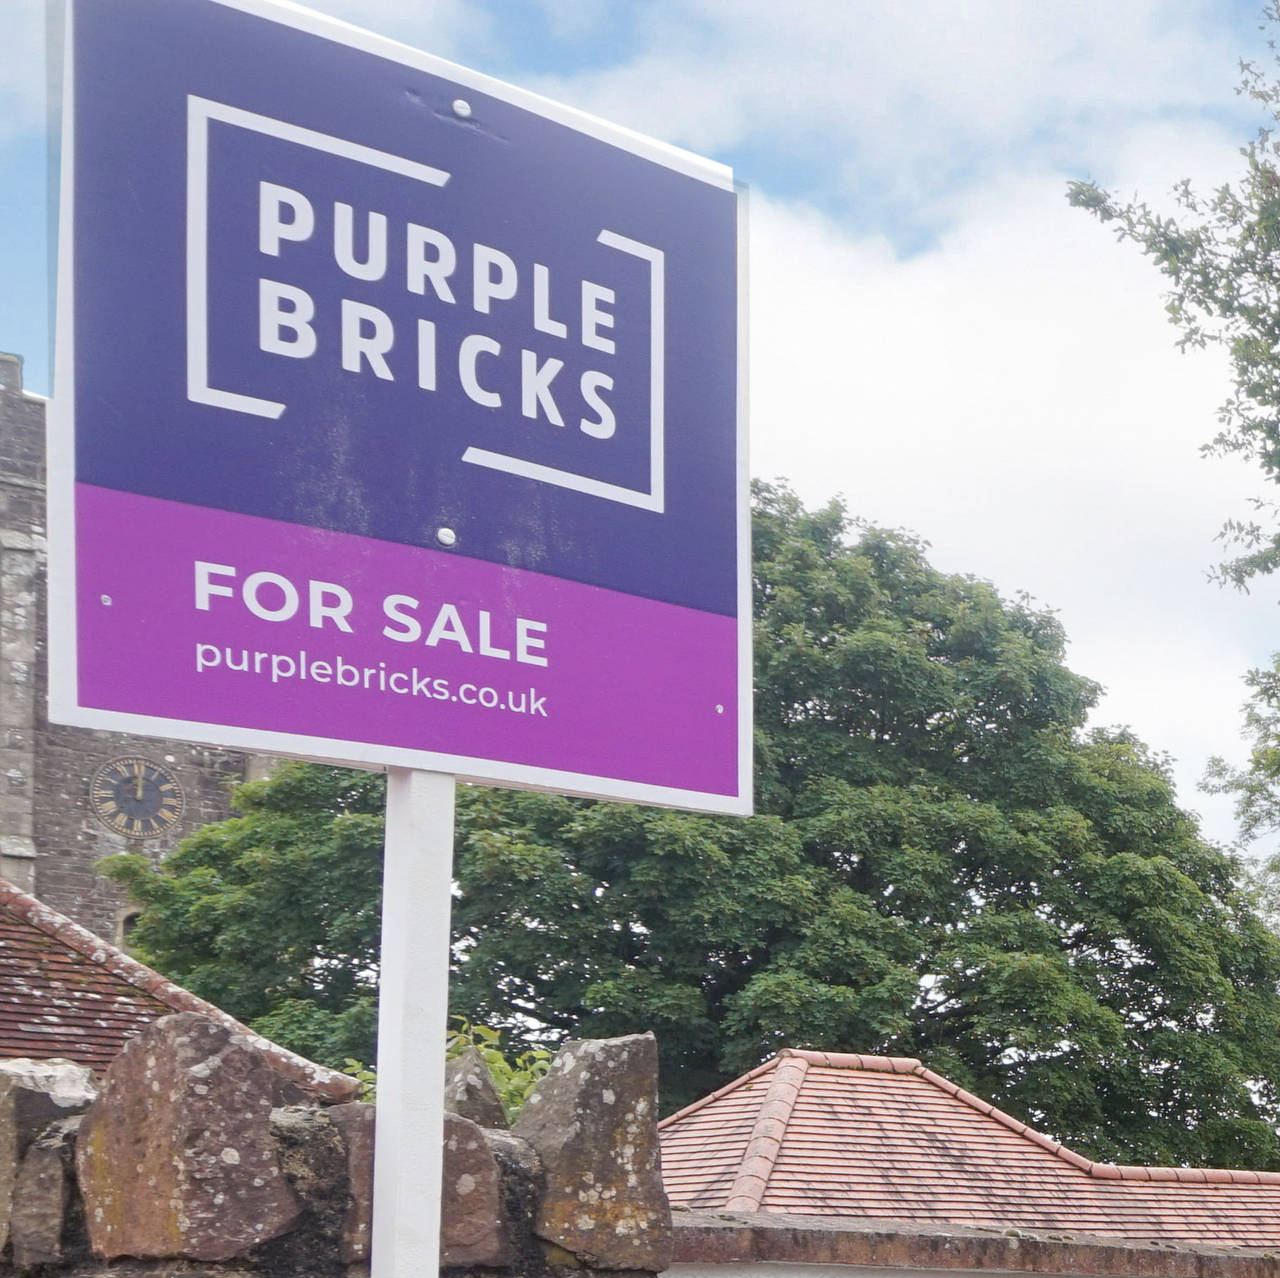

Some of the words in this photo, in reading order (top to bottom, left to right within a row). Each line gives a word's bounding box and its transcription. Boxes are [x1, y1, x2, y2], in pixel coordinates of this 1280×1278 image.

[259, 181, 616, 355] PURPLE
[259, 278, 616, 440] BRICKS
[194, 560, 354, 633] FOR
[382, 594, 548, 668] SALE
[196, 642, 548, 717] purplebricks.co.uk
